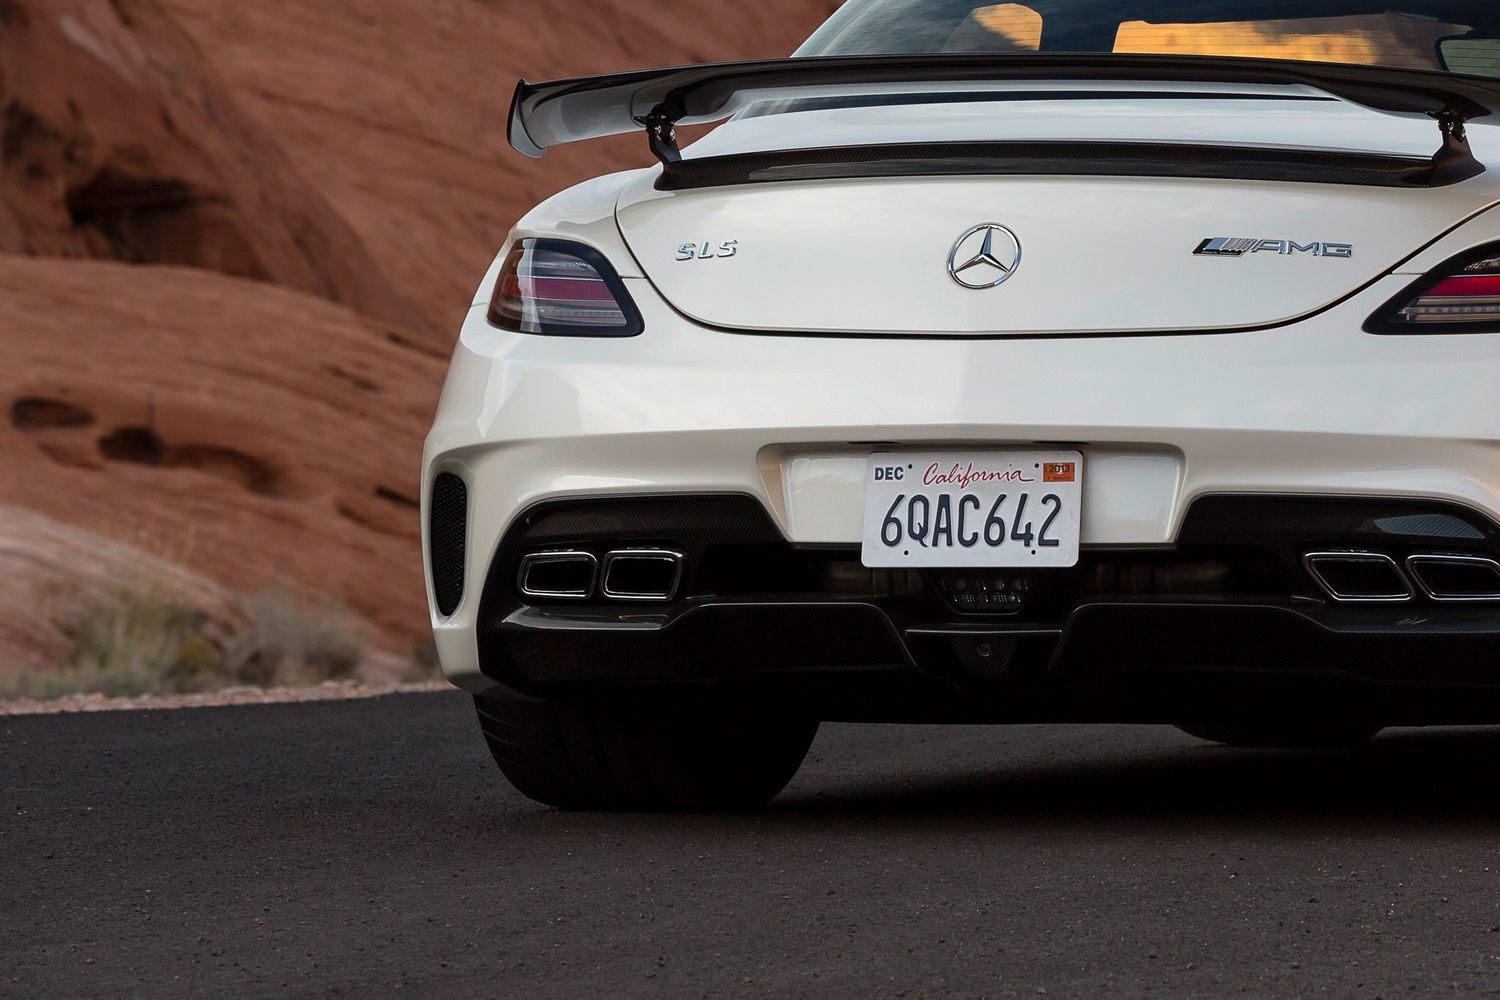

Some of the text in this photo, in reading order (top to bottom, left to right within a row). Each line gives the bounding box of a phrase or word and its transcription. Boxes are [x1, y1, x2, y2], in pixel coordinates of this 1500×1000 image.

[675, 240, 738, 261] SLS
[1251, 239, 1352, 258] AMG
[874, 466, 904, 481] DEC
[923, 462, 1034, 489] California
[1049, 464, 1070, 473] 2013
[880, 493, 1061, 548] 6QAC642
